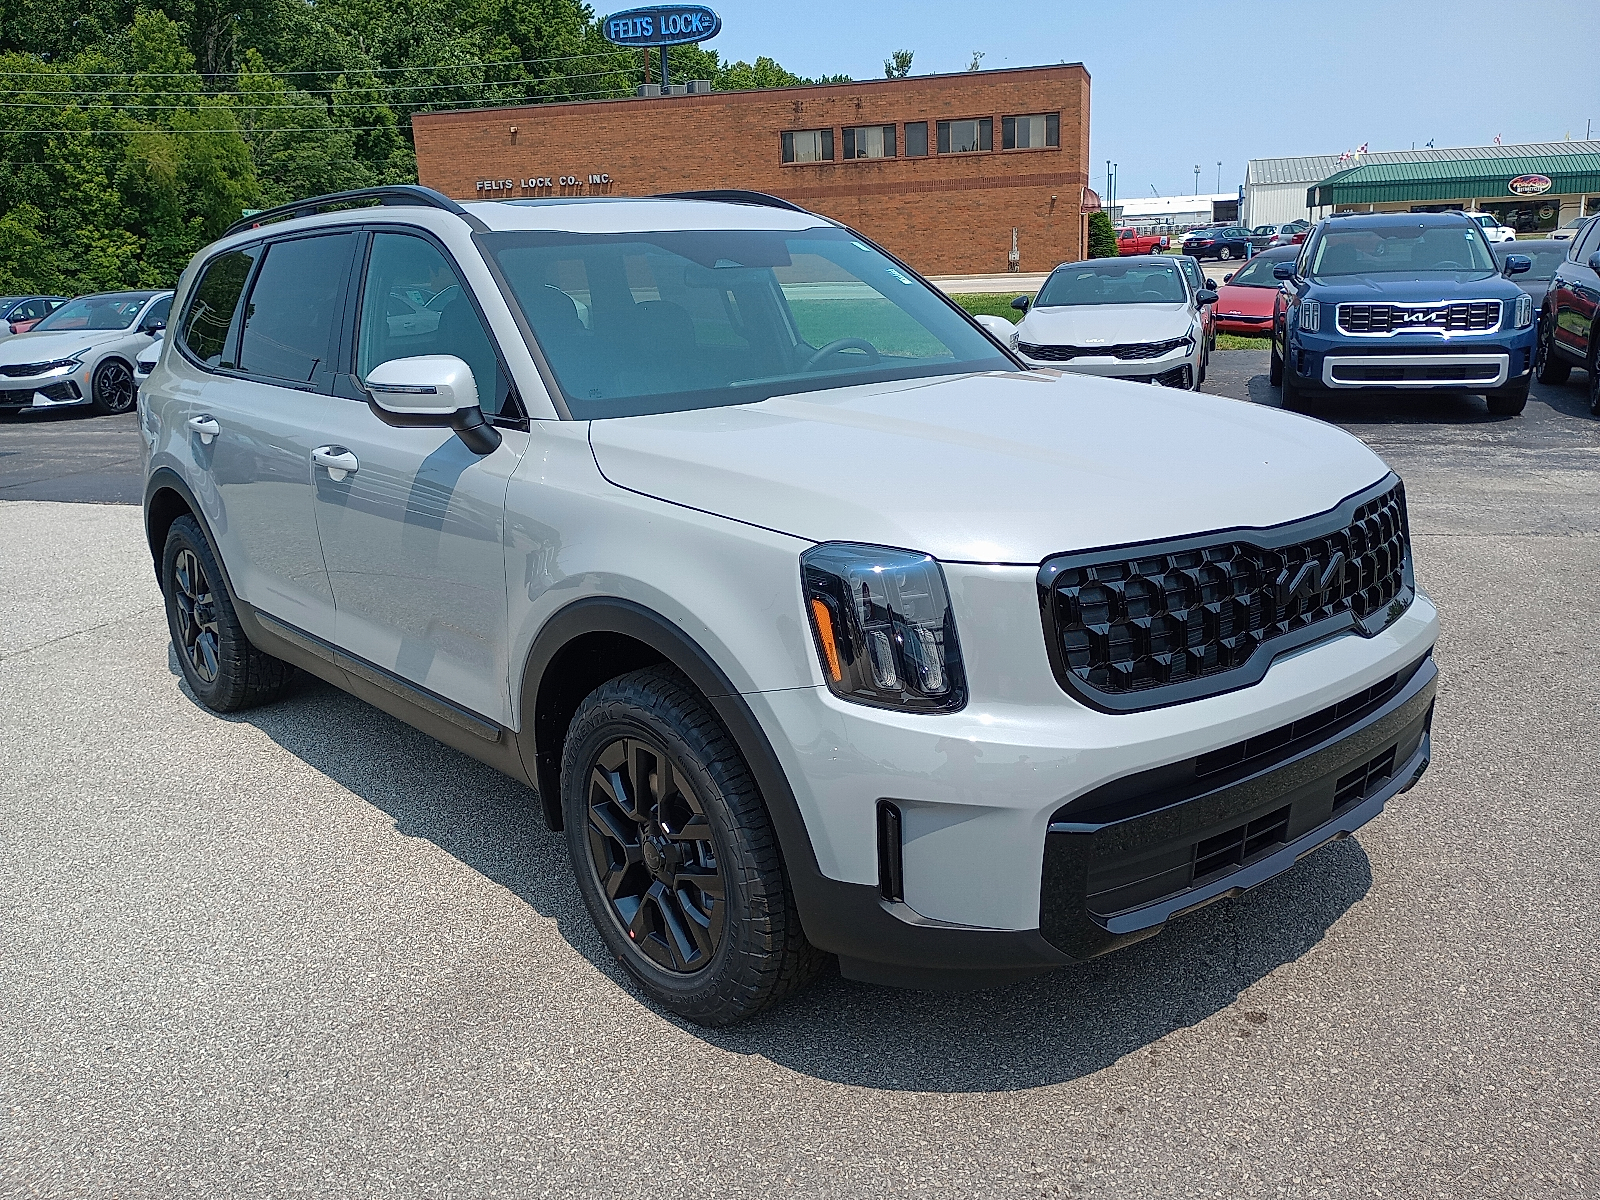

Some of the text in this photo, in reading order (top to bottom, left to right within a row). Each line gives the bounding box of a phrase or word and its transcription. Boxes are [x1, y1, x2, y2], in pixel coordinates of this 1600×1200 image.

[609, 16, 653, 39] FELTS
[660, 12, 703, 35] LOCK
[476, 173, 614, 191] FELTS LOCK CO., INC.
